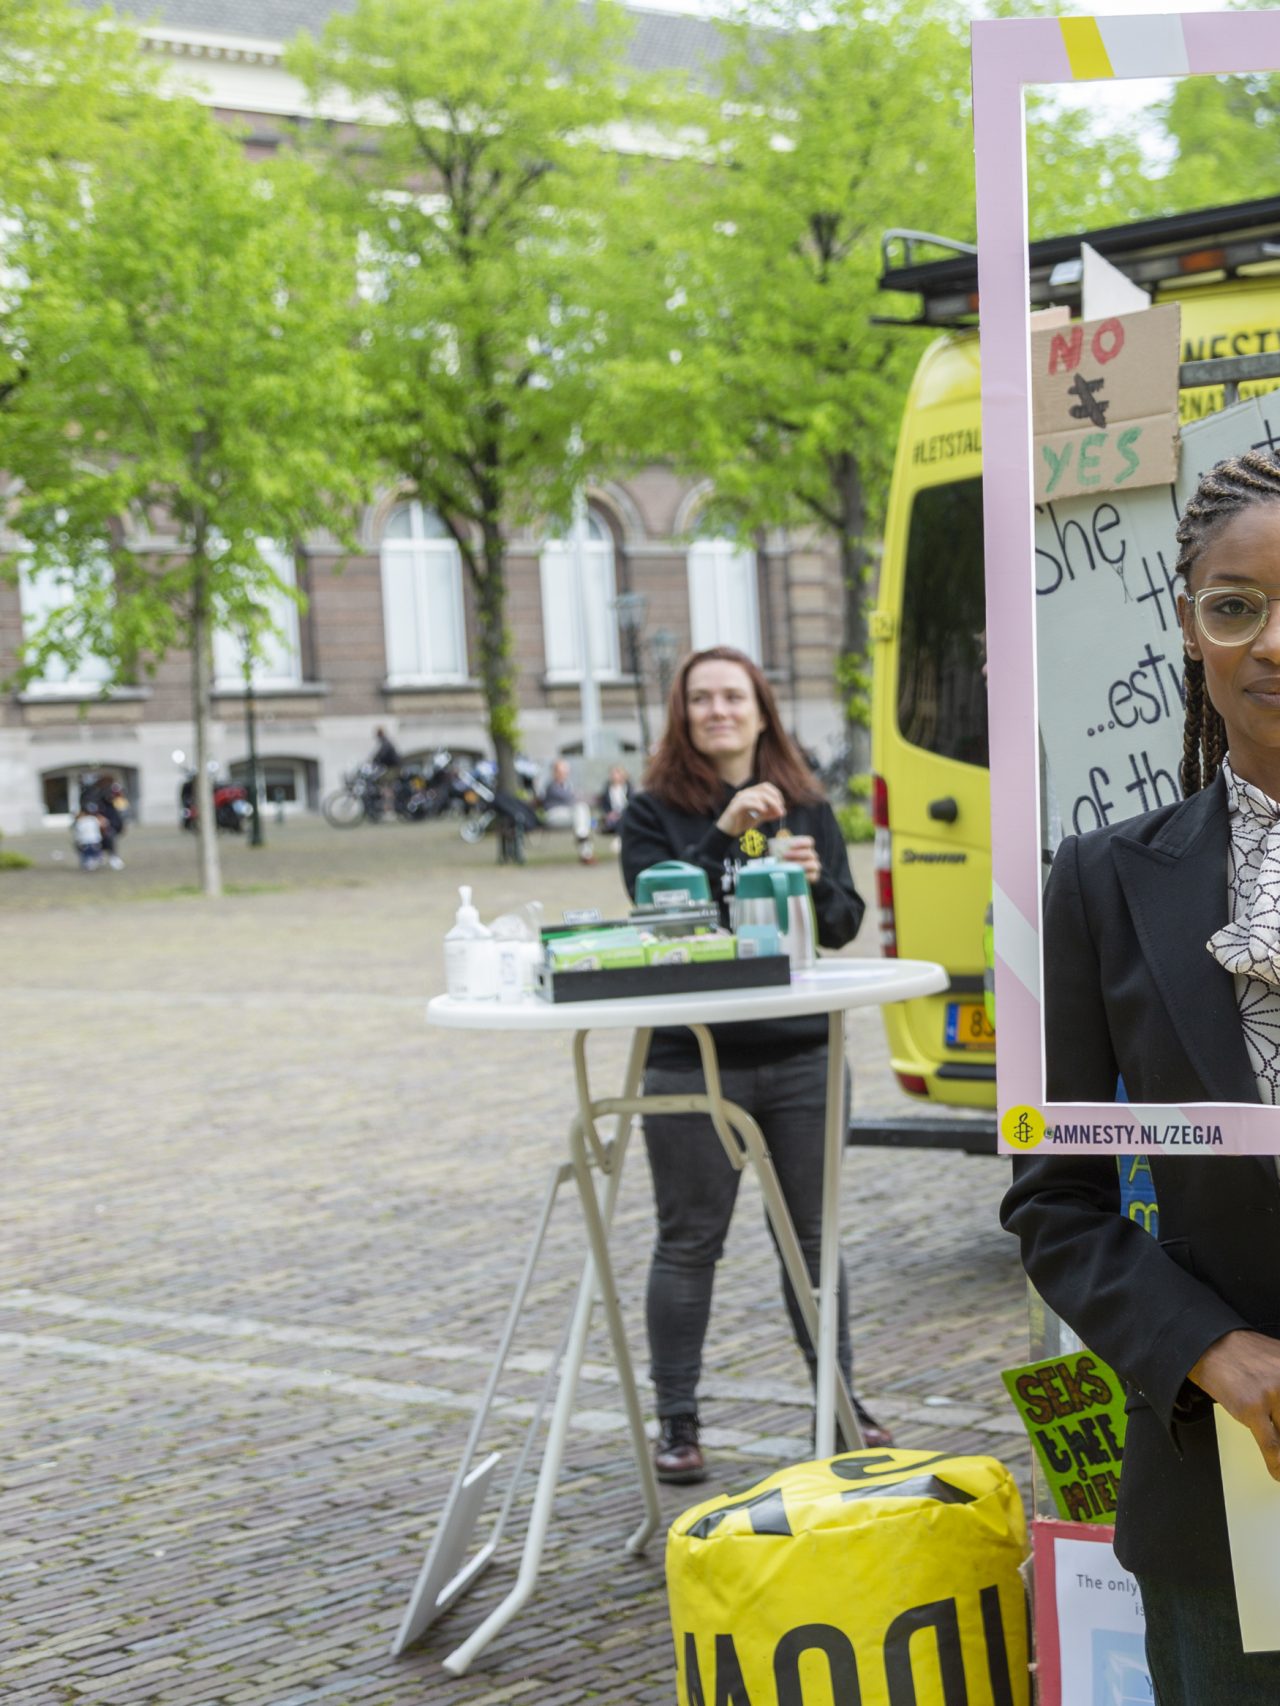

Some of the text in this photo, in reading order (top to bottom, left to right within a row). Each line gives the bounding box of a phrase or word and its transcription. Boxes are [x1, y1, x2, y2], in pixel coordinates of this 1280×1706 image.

[1049, 317, 1126, 375] NO
[1041, 427, 1142, 494] YES
[1052, 1125, 1224, 1147] AMNESTY.NL/ZEGJA
[1015, 1356, 1113, 1425] SEKS
[1077, 1574, 1138, 1598] The only
